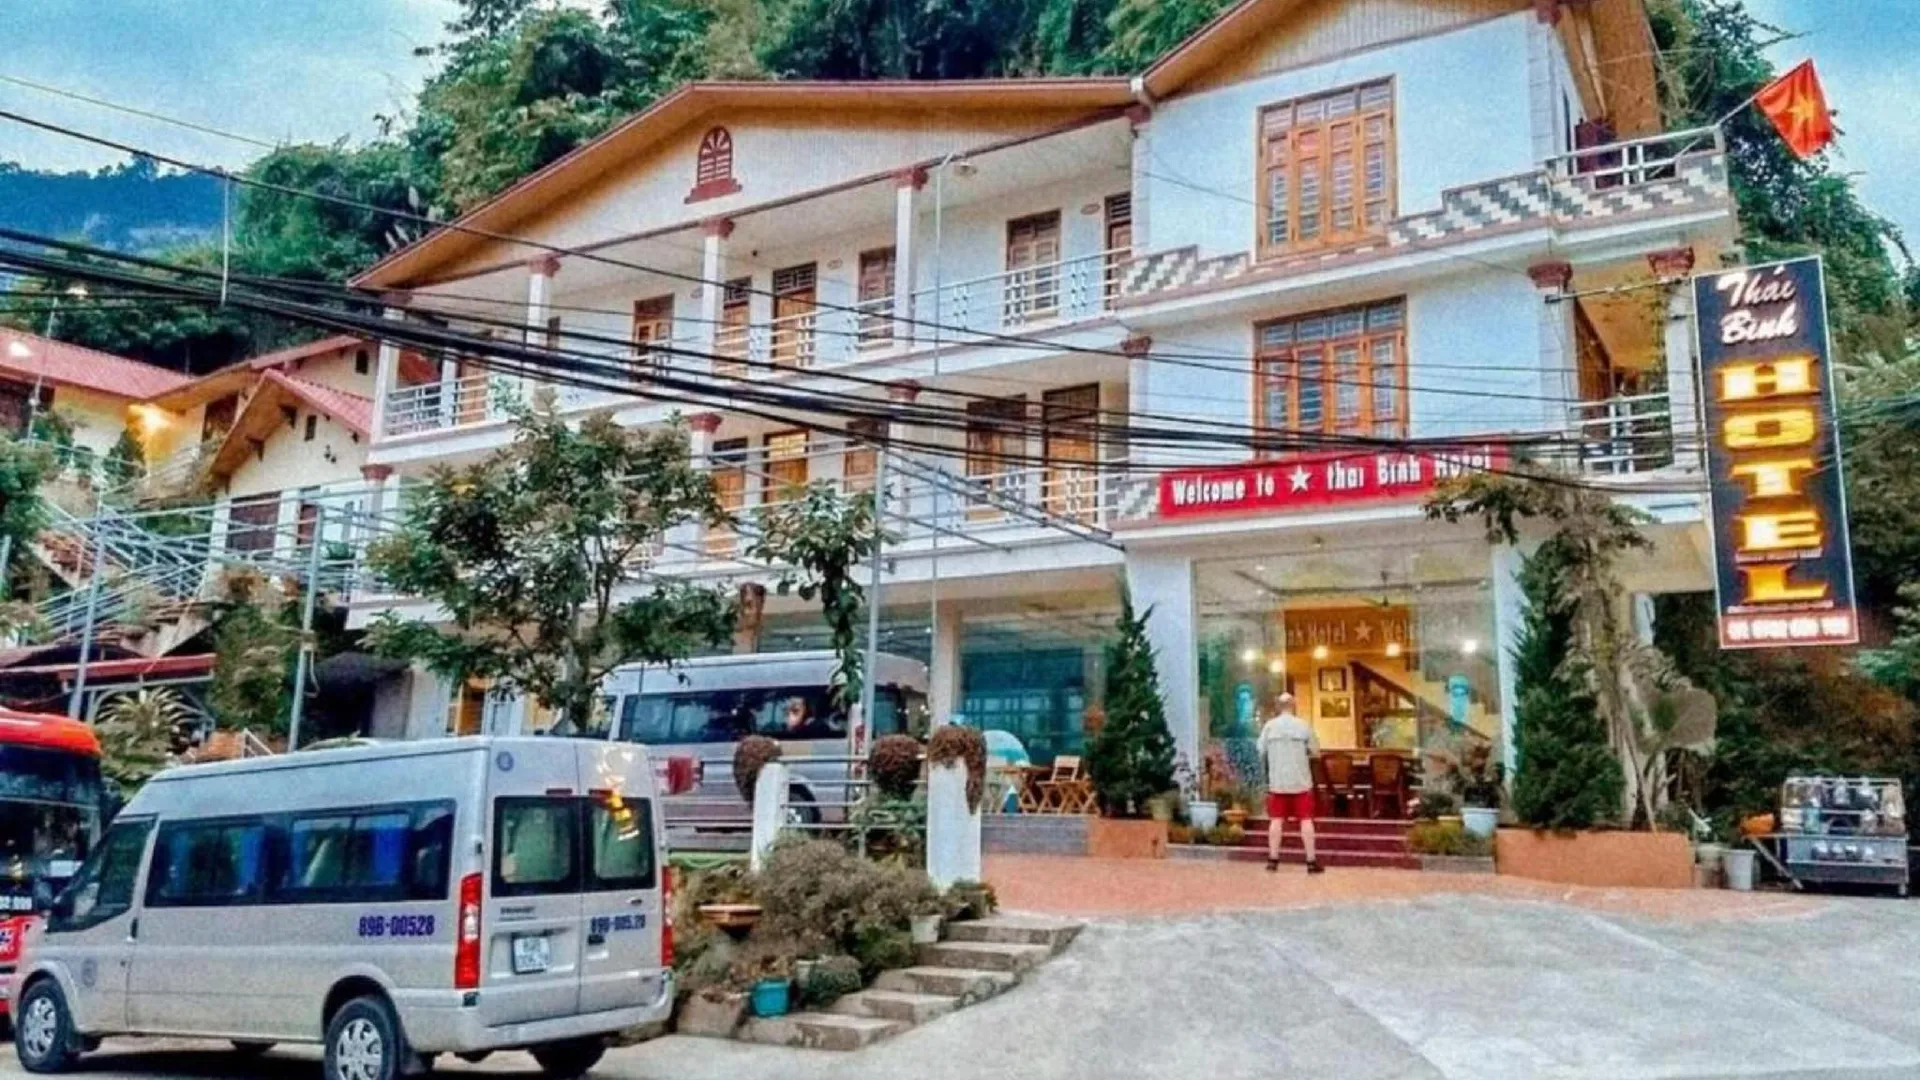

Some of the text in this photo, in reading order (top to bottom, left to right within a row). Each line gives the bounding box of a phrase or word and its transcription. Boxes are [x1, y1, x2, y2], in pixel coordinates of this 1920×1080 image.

[1171, 474, 1247, 506] Welcome
[1256, 471, 1276, 498] to
[1715, 356, 1829, 602] HOTEL
